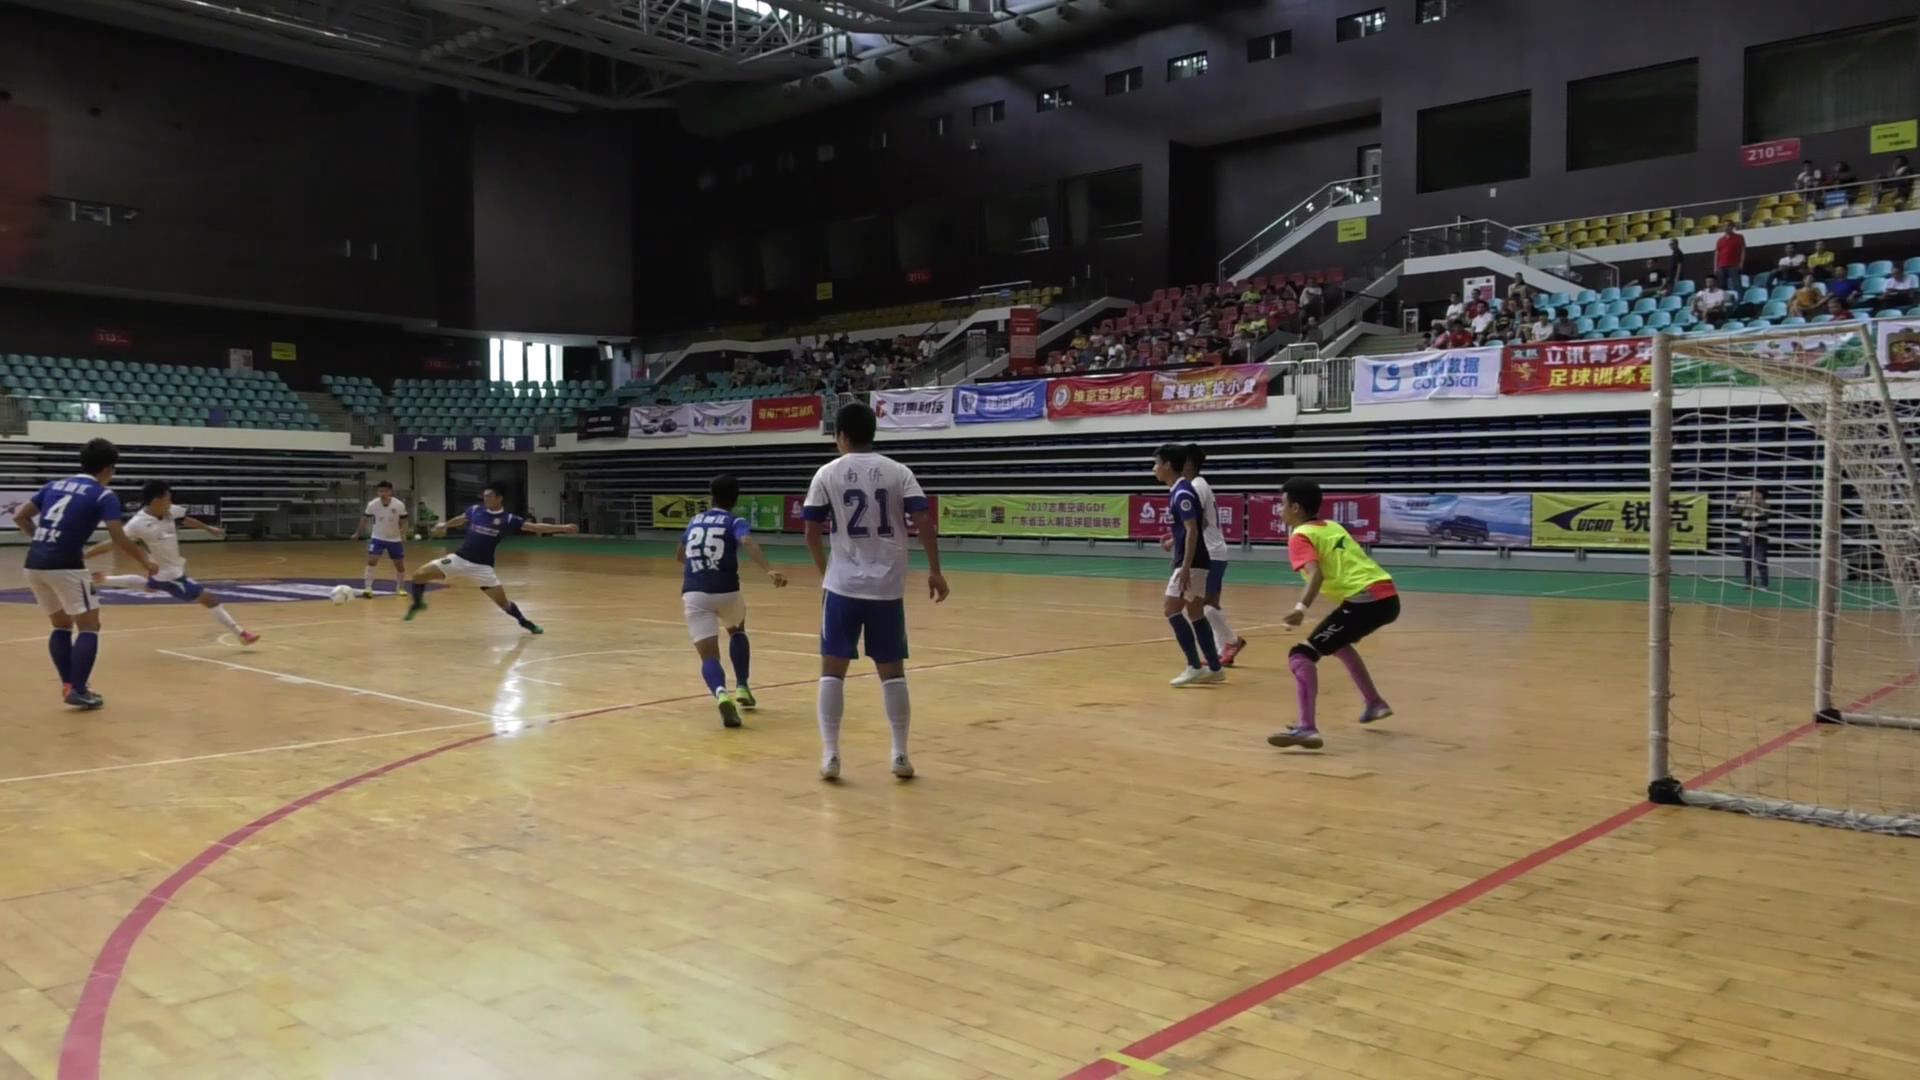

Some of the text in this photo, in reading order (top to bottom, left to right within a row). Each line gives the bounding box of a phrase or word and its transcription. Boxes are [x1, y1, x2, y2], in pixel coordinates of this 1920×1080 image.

[1748, 147, 1774, 161] 210
[412, 437, 516, 451] 广州黄埔
[45, 494, 73, 528] 4
[843, 488, 894, 538] 21
[685, 527, 726, 560] 25
